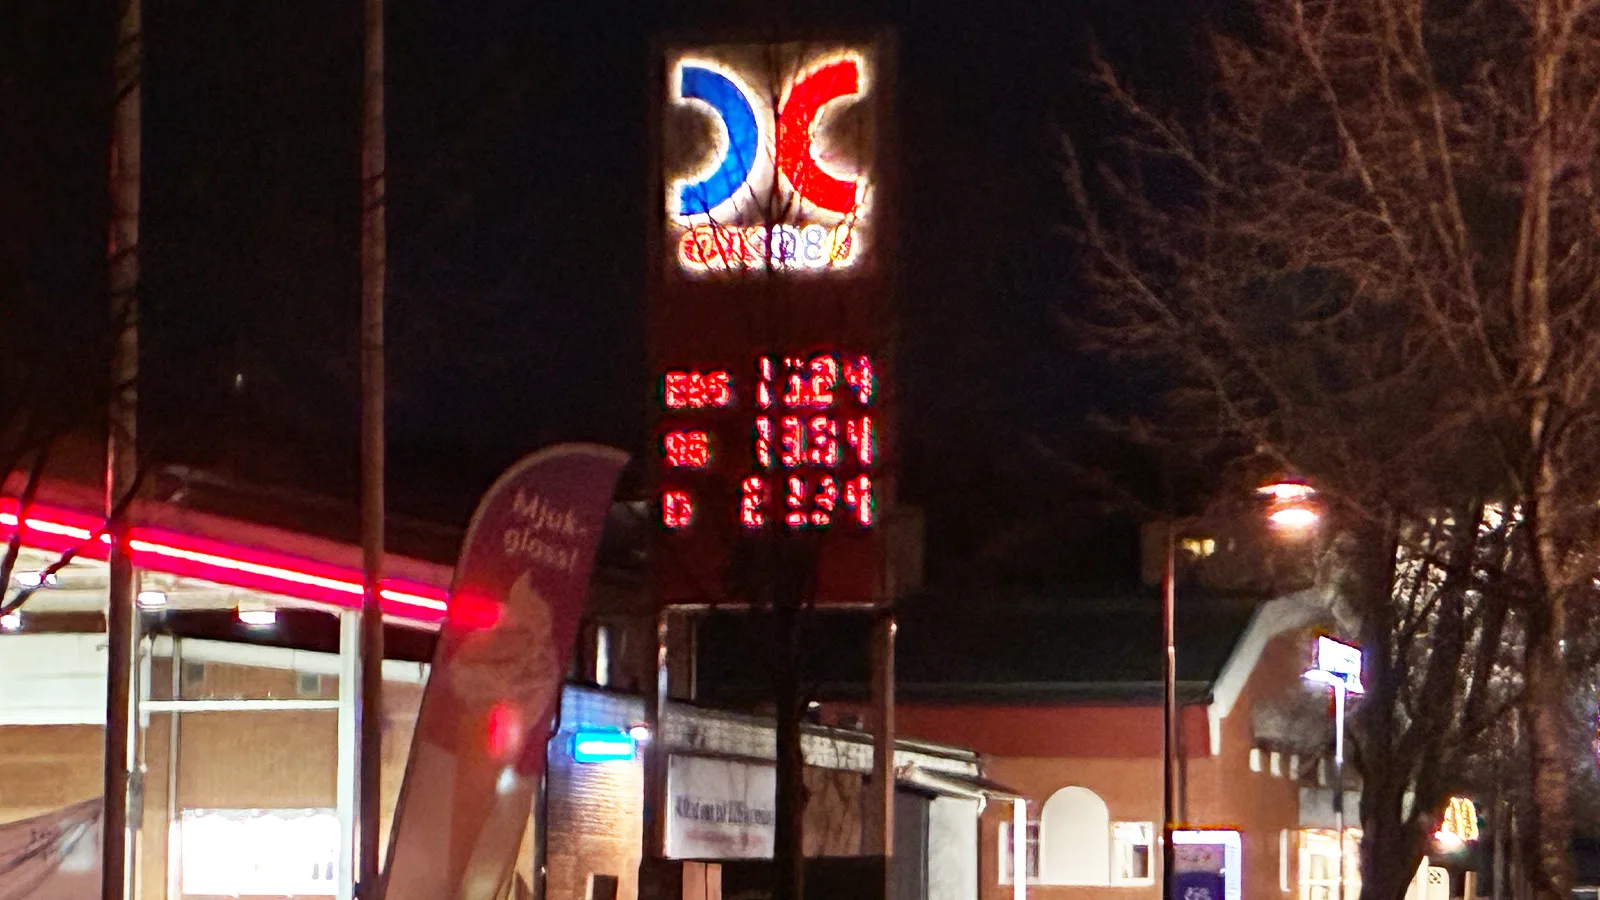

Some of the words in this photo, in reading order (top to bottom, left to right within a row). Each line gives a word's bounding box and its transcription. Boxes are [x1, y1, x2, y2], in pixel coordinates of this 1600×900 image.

[665, 371, 731, 408] E85
[665, 431, 710, 467] 95
[663, 491, 693, 527] D
